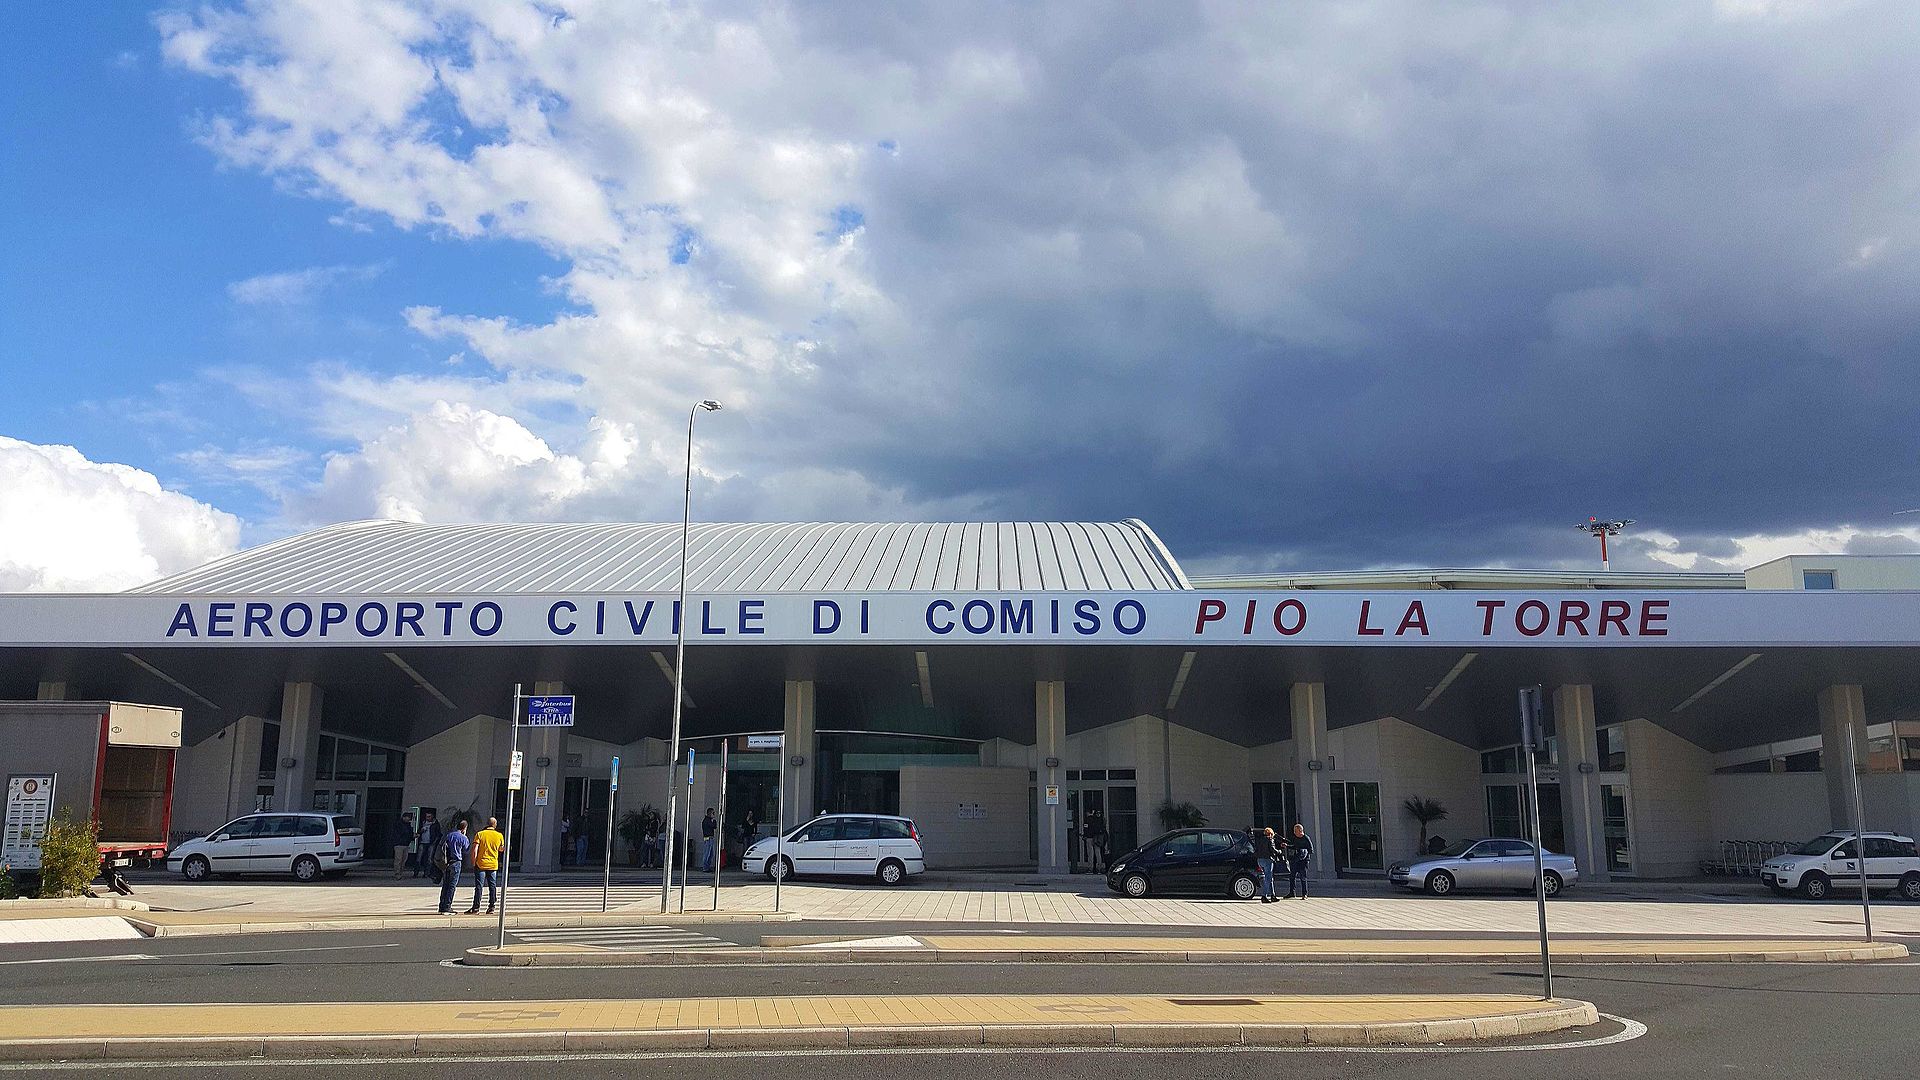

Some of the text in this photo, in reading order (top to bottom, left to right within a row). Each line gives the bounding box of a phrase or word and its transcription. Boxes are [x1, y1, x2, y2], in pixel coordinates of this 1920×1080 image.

[166, 599, 1670, 637] AEROPORTO CIVILE DI COMISO PIO LA TORRE
[529, 714, 571, 725] FERMATA
